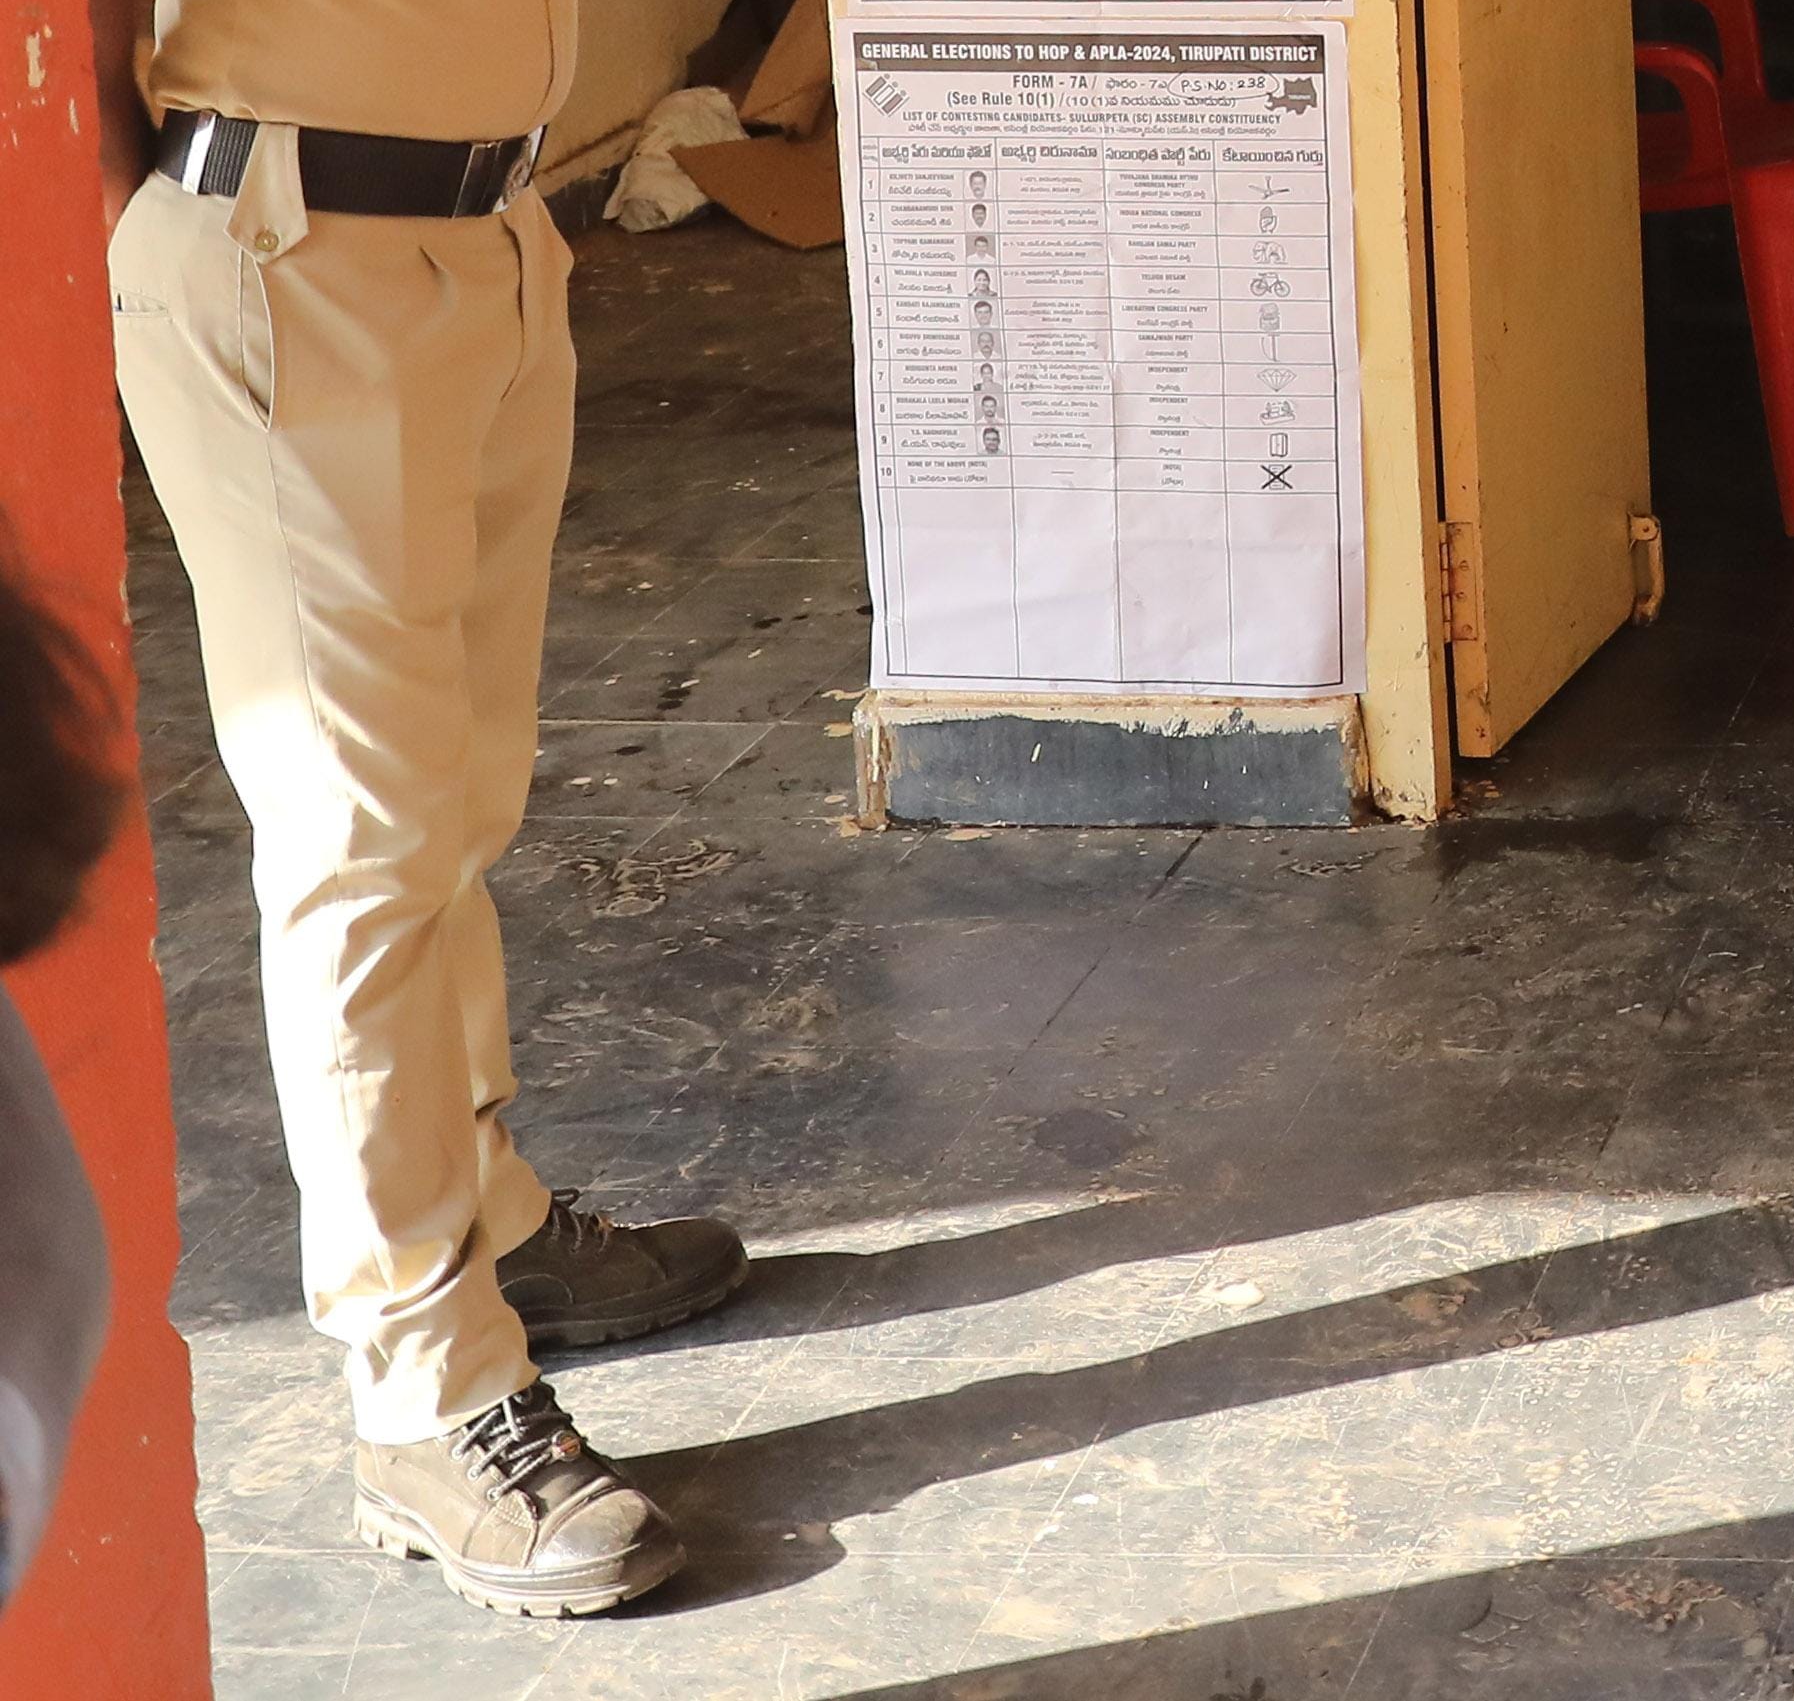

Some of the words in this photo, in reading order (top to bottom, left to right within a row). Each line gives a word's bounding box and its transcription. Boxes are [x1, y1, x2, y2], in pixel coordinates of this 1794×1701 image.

[862, 44, 928, 59] GENERAL
[932, 44, 1012, 60] ELECTIONS
[1016, 45, 1034, 61] TO
[1039, 45, 1071, 60] HOP
[1074, 45, 1087, 59] &
[1089, 45, 1175, 63] APLA-2024,
[1179, 45, 1245, 62] TIRUPATI
[1249, 46, 1318, 62] DISTRICT
[1013, 75, 1054, 88] FORM
[1070, 75, 1088, 88] 7A
[1238, 76, 1266, 89] 238
[947, 92, 978, 106] (See
[982, 92, 1013, 105] Rule
[1018, 93, 1055, 108] 10(1)
[902, 112, 923, 121] LIST
[925, 112, 938, 121] OF
[941, 112, 1000, 122] CONTESTING
[1132, 113, 1153, 125] (SC)
[1155, 114, 1205, 124] ASSEMBLY
[1209, 114, 1281, 125] CONSTITUENCY
